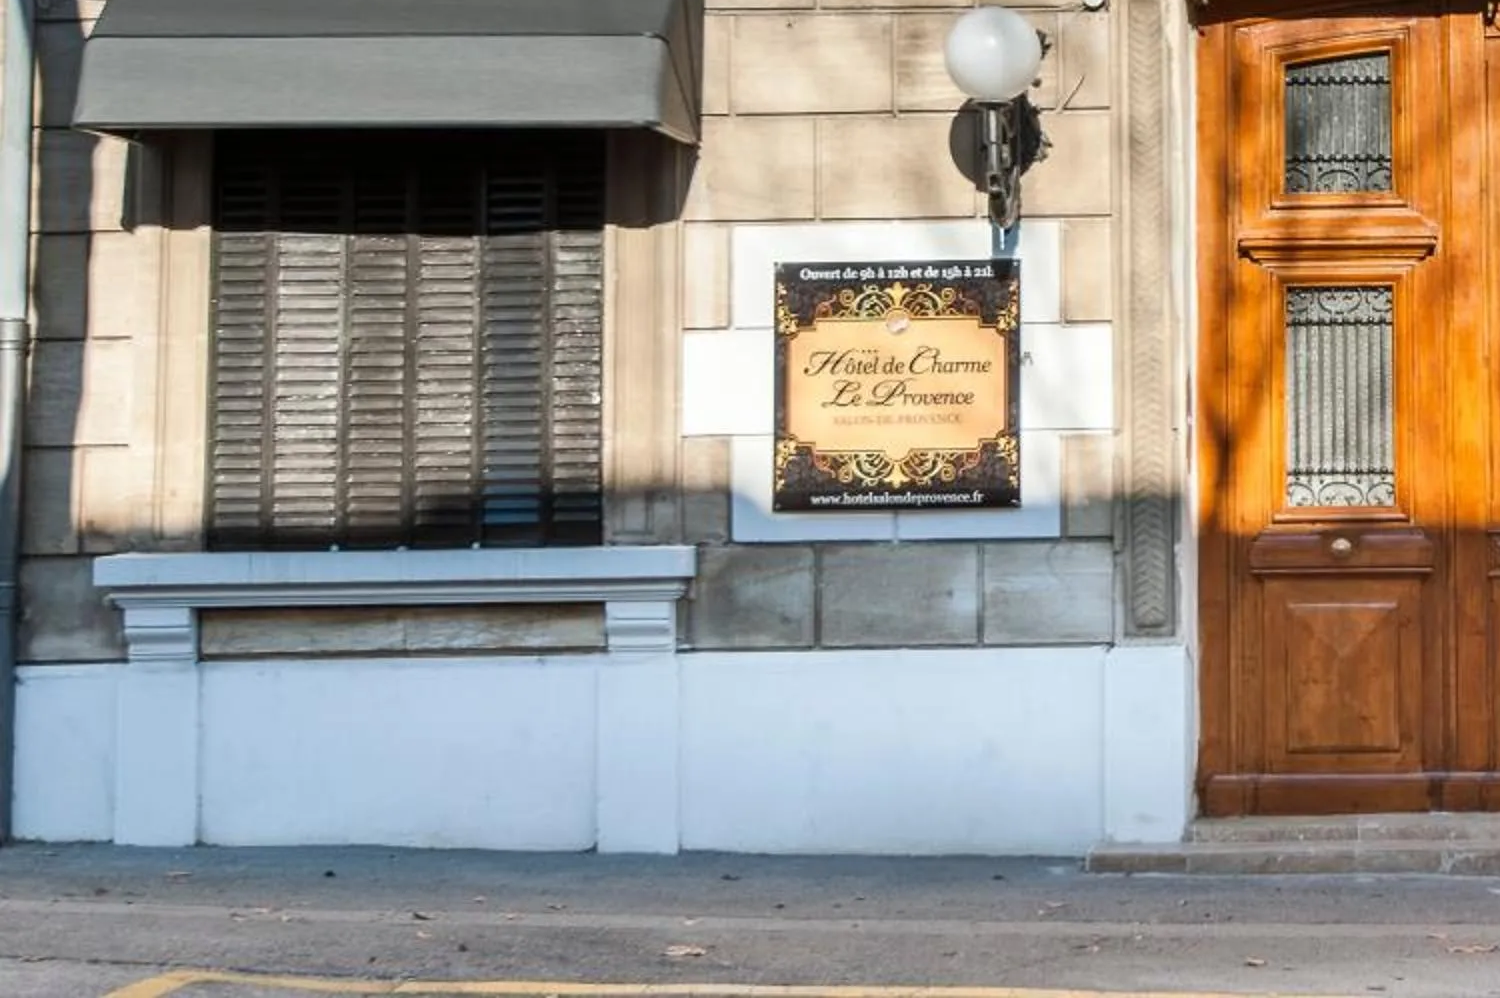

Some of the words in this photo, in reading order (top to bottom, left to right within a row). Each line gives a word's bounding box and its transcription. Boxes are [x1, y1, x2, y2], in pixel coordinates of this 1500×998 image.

[800, 267, 841, 281] Ouvert
[887, 266, 909, 279] 12h
[910, 267, 923, 279] et
[924, 266, 940, 279] de
[803, 349, 880, 376] Hôtel
[882, 356, 905, 375] de
[908, 345, 992, 375] Charme
[821, 379, 862, 408] Le
[865, 377, 975, 407] Provence
